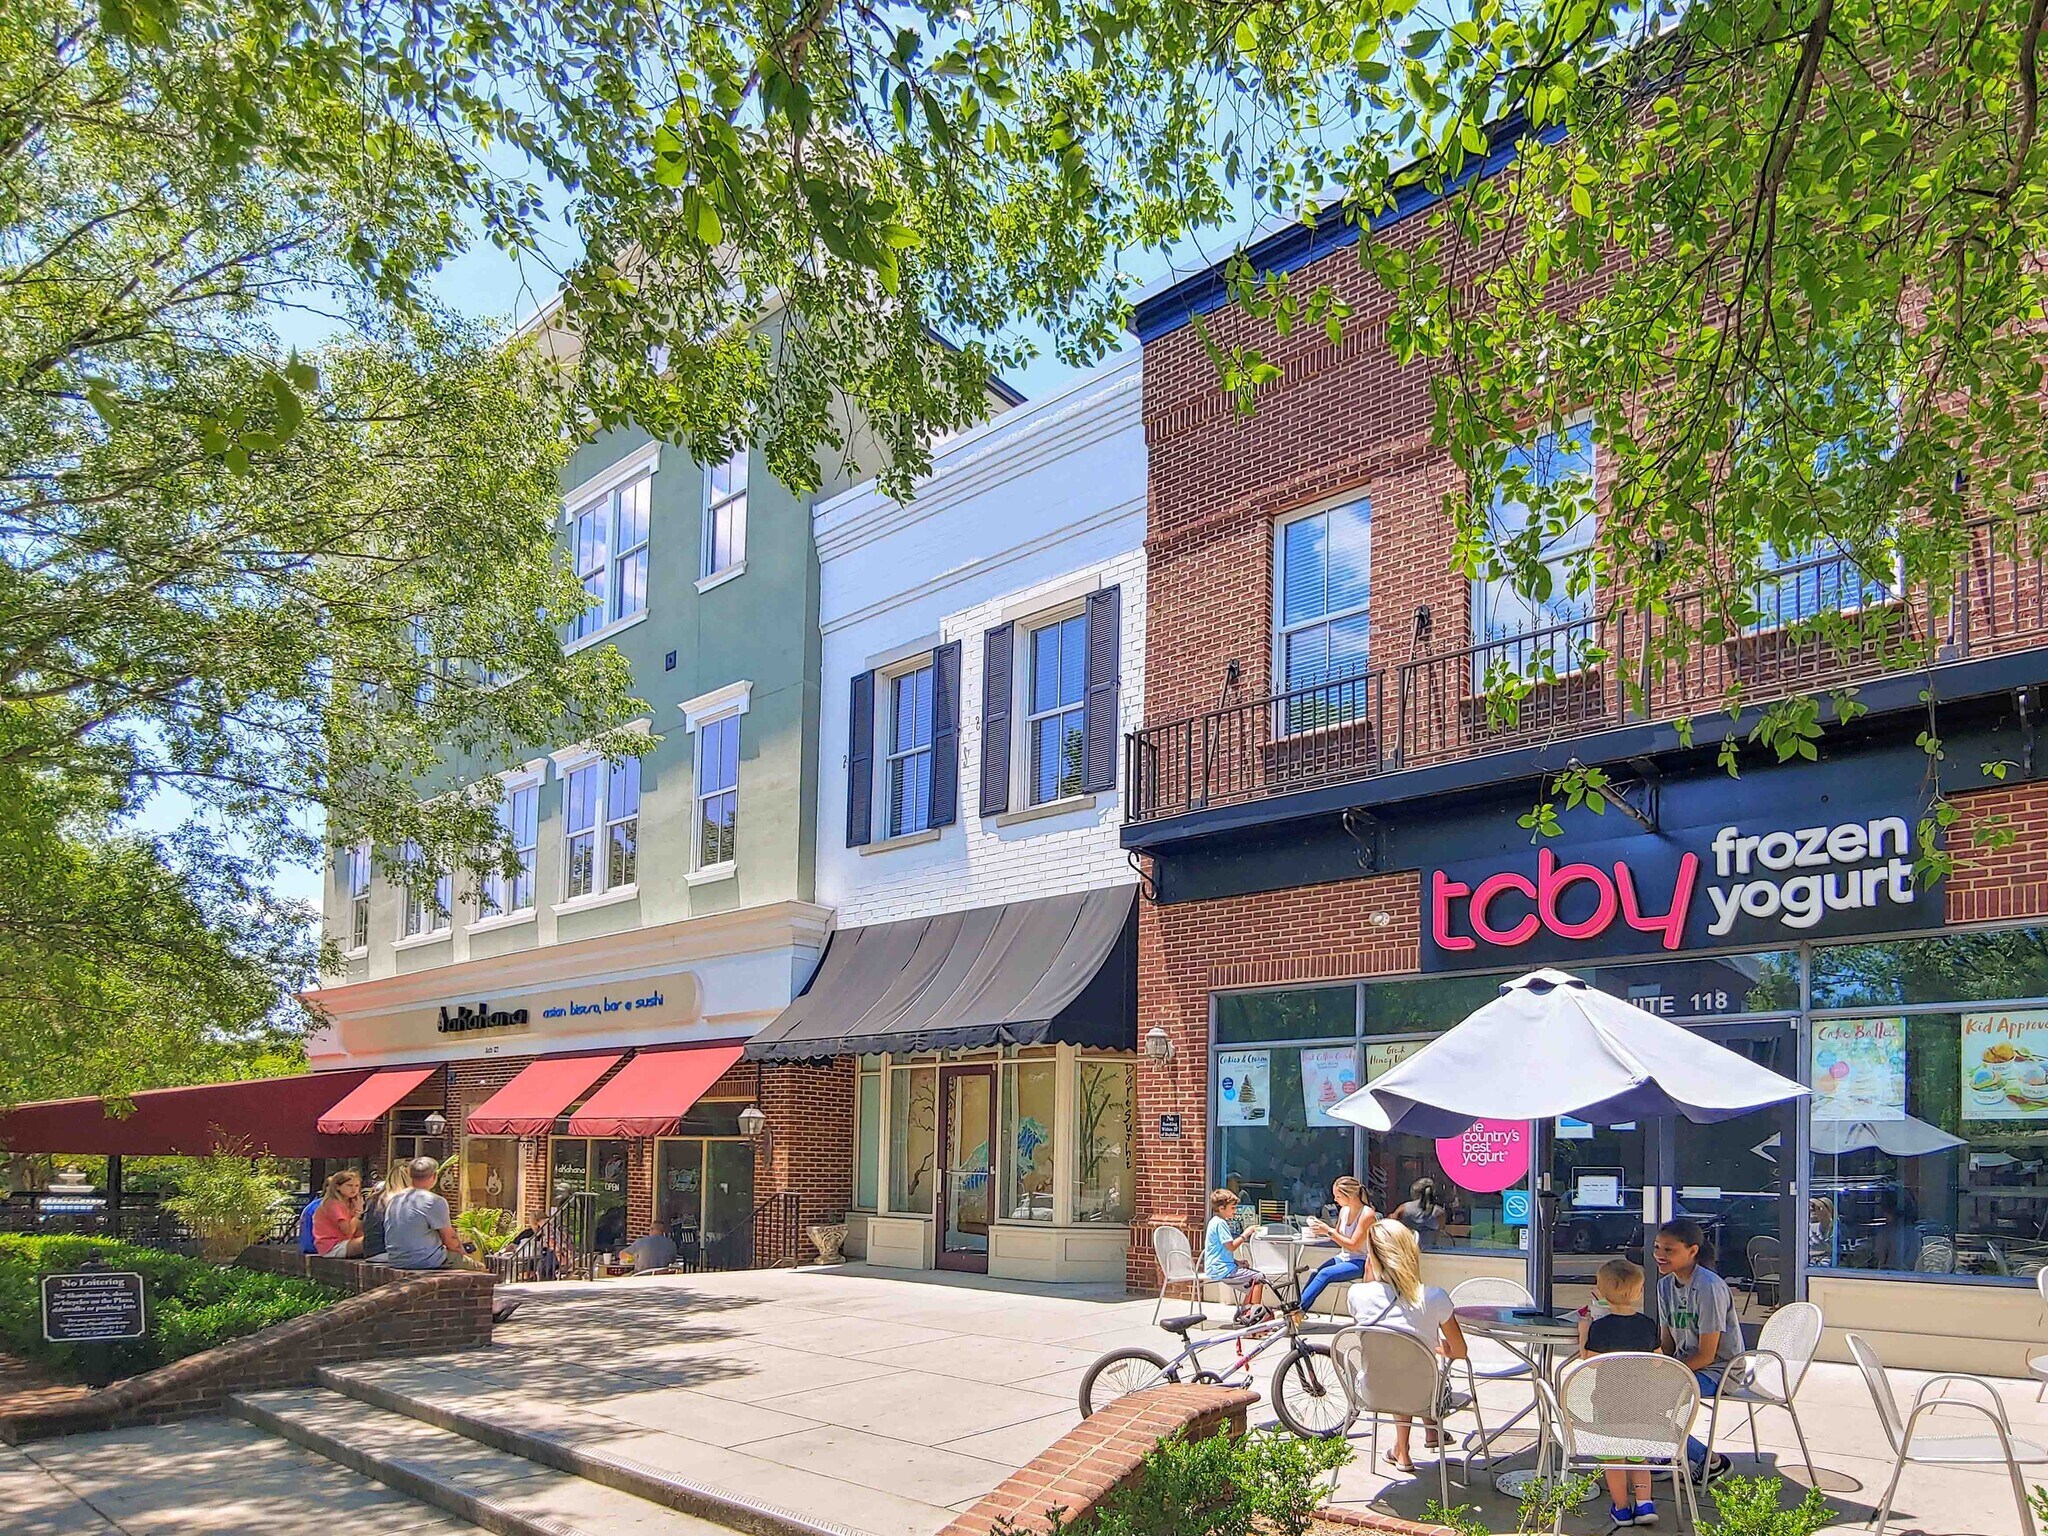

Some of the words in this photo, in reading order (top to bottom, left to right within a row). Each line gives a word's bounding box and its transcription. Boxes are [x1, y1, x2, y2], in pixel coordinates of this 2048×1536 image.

[1711, 815, 1908, 877] frozen
[1432, 847, 1699, 950] tcby
[1707, 859, 1914, 936] yogurt
[543, 1006, 567, 1018] asian
[604, 996, 623, 1012] bar
[636, 990, 664, 1009] sushi
[1689, 990, 1728, 1011] 118
[1965, 1016, 1994, 1035] Kid
[1463, 1130, 1520, 1145] country's
[1463, 1141, 1491, 1152] best
[604, 1182, 620, 1192] OPEN
[61, 1279, 77, 1287] No
[79, 1278, 125, 1287] Loitering
